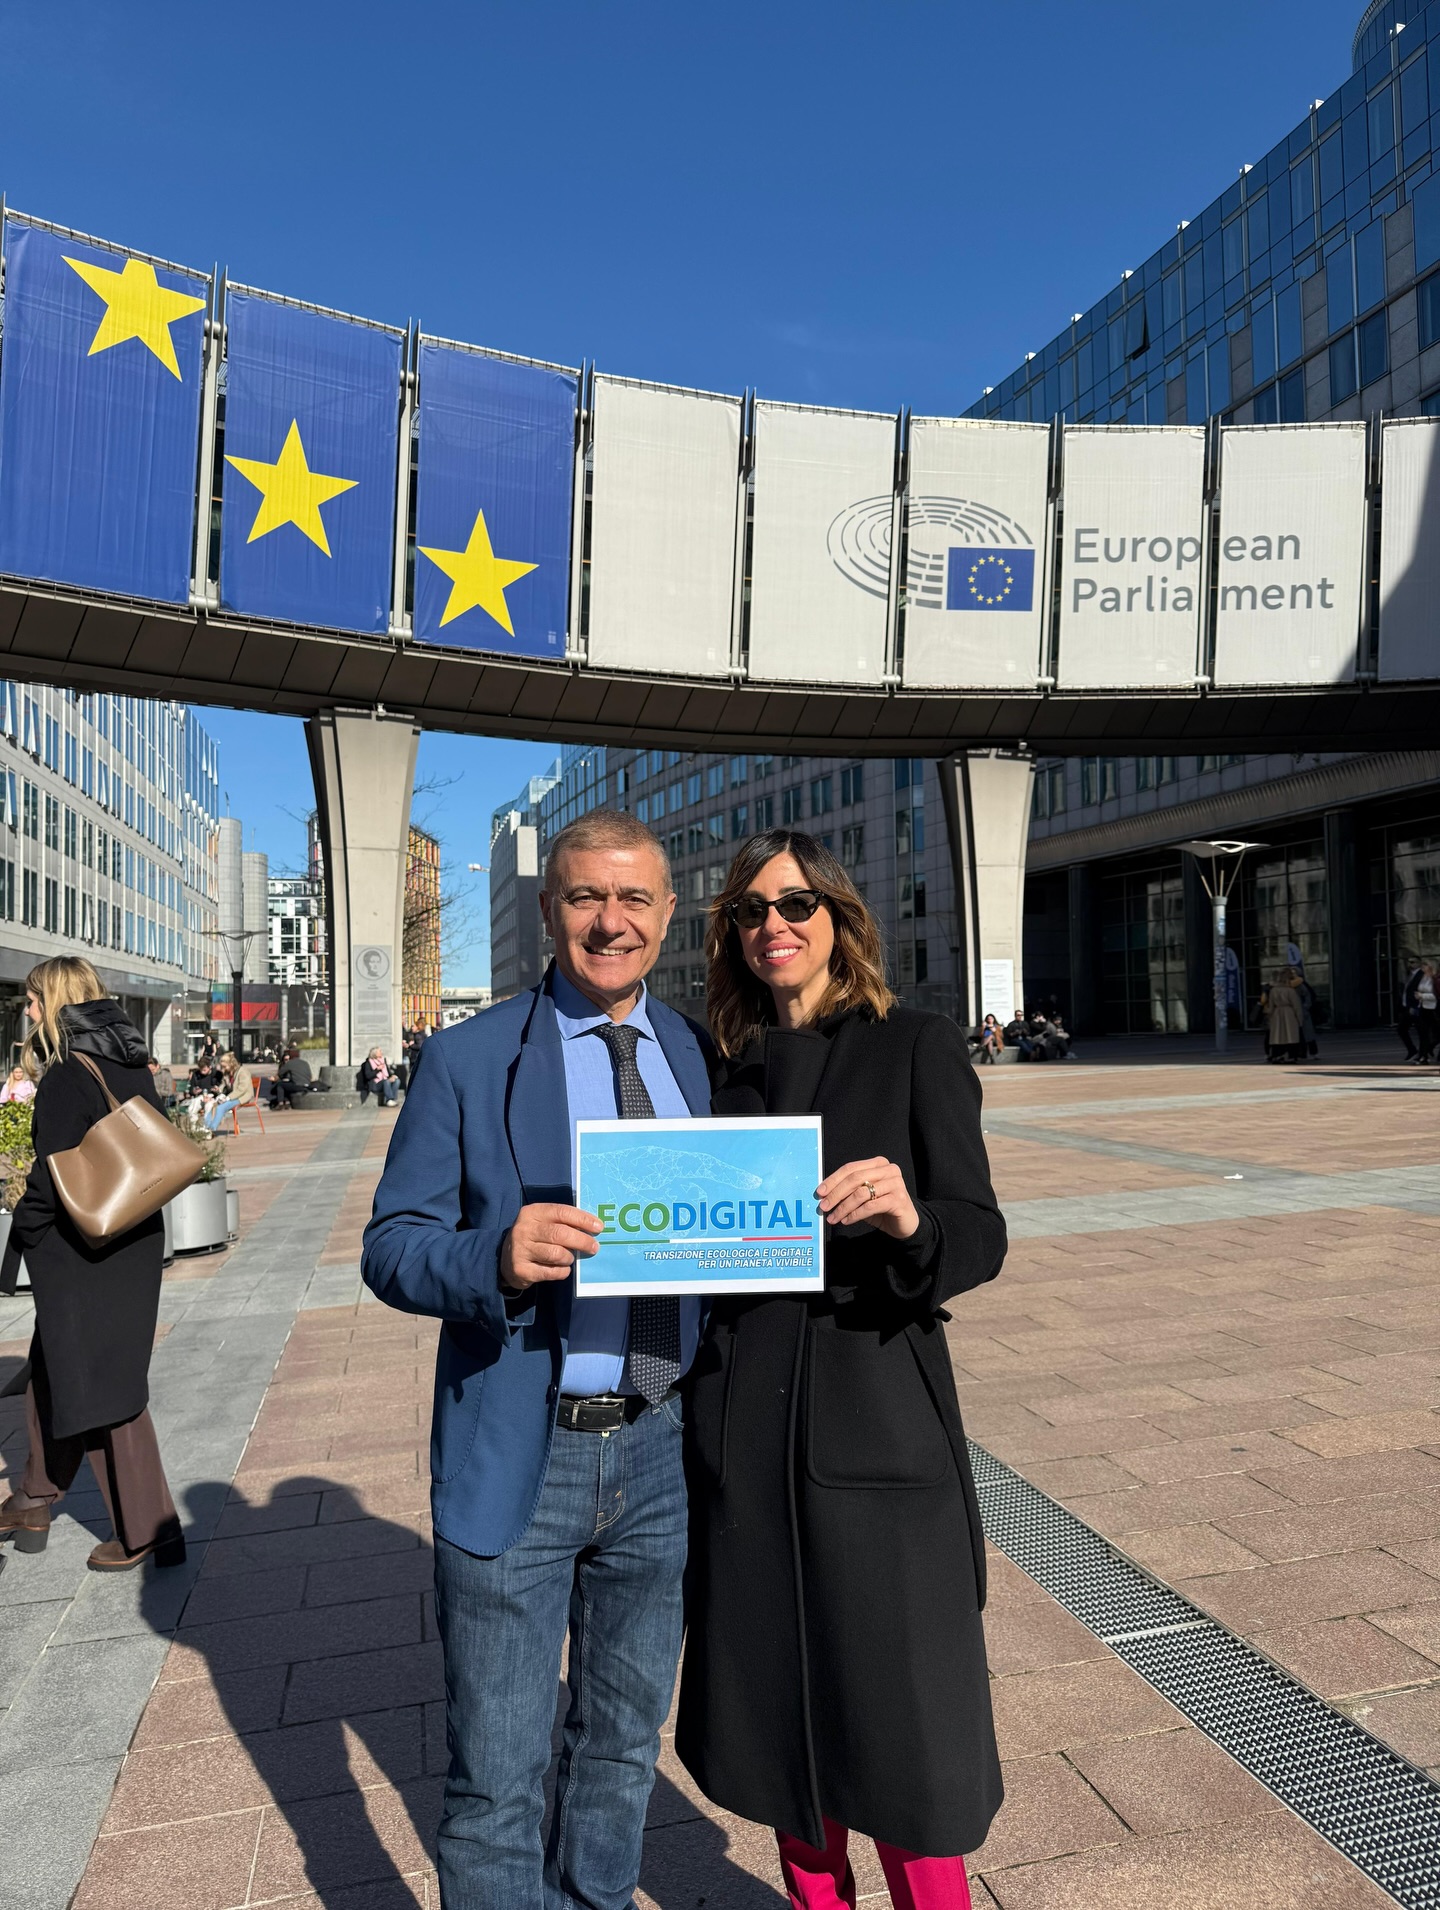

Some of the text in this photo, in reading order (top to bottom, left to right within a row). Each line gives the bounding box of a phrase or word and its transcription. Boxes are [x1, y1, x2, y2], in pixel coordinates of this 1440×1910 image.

[1074, 528, 1301, 571] European
[1072, 574, 1335, 613] Parliament
[597, 1199, 813, 1233] ECODIGITAL
[644, 1247, 813, 1260] TRANSIZIONE ECOLOGICA E DIGITALE
[698, 1257, 813, 1269] PER UN PIANETA VIVIBILE
